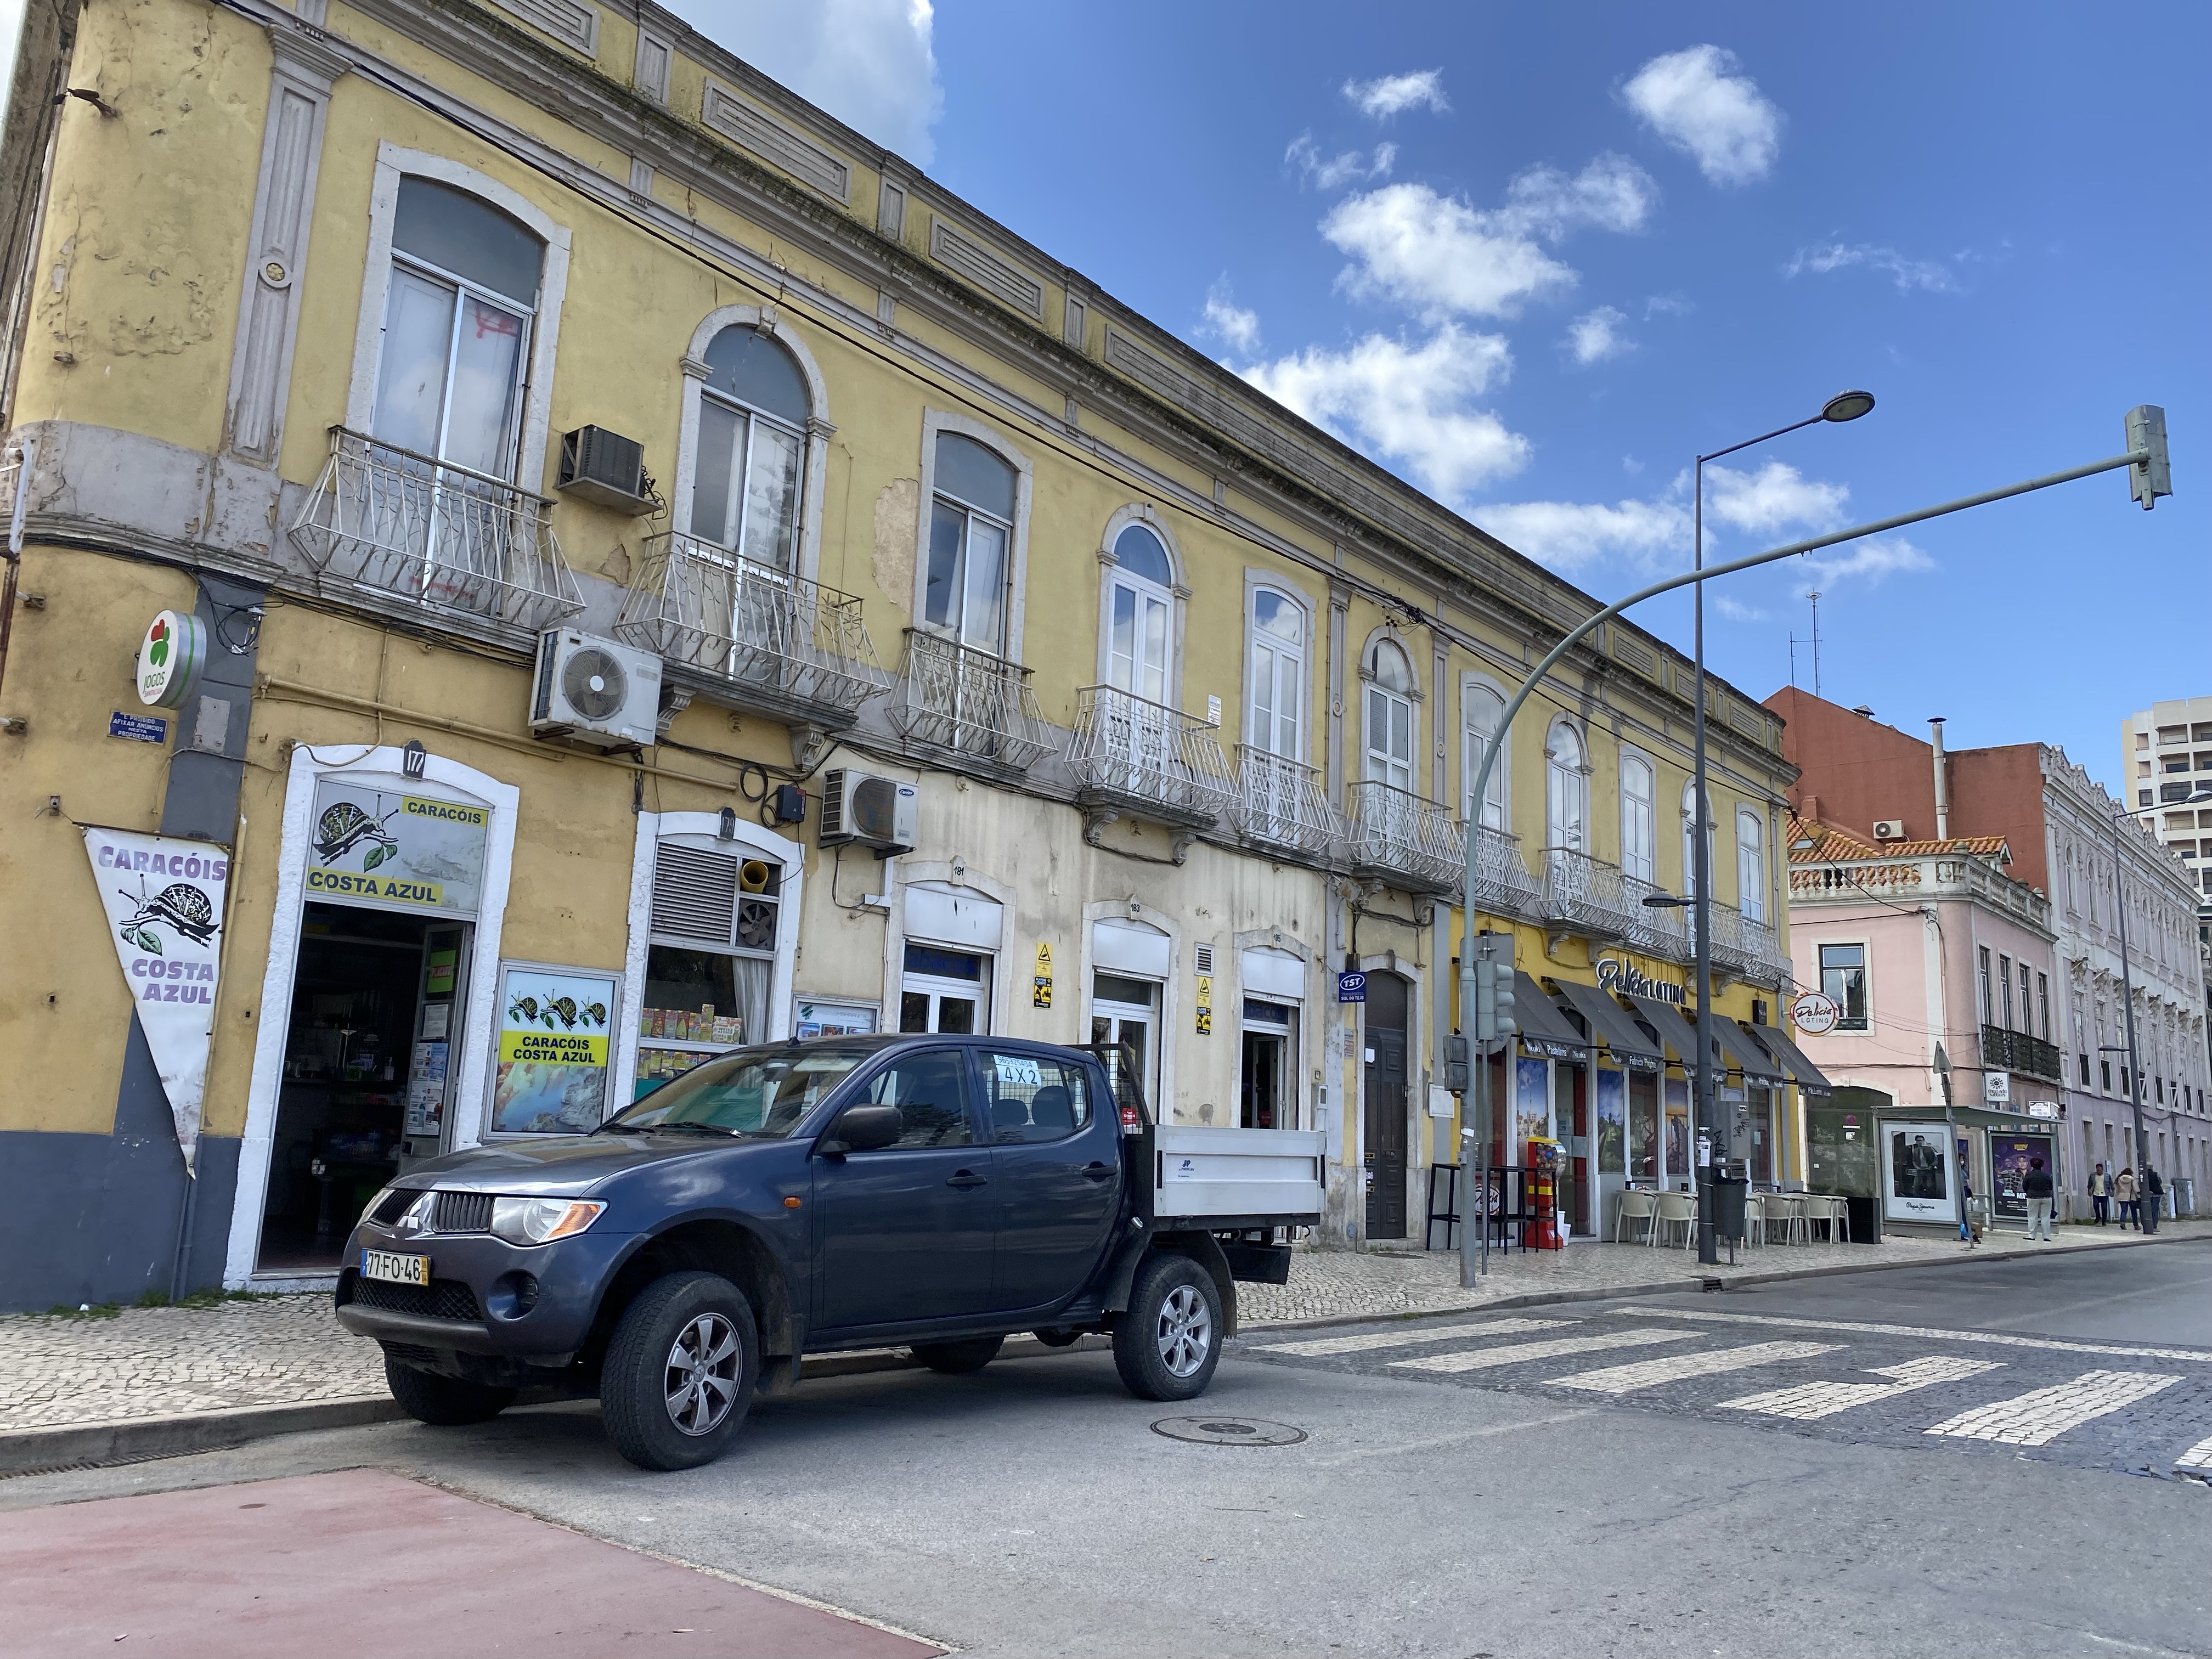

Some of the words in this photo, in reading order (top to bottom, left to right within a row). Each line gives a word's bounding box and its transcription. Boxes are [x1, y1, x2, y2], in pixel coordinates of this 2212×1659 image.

[143, 672, 166, 694] JOGOS
[112, 718, 135, 727] AFIXAR
[137, 722, 163, 732] ANÚNCIOS
[129, 715, 155, 724] PROIBIDO
[117, 730, 156, 742] PROPRIEDADE
[407, 802, 481, 824] CARACÓIS
[721, 816, 735, 834] 179
[98, 845, 227, 881] CARACÓIS
[953, 866, 964, 876] 181
[309, 871, 378, 894] COSTA
[384, 883, 437, 902] AZUL
[1131, 903, 1140, 913] 183
[132, 958, 214, 981] COSTA
[1344, 978, 1361, 988] TST
[142, 983, 212, 1005] AZUL
[522, 1036, 589, 1050] CARACÓIS
[513, 1048, 557, 1061] COSTA
[561, 1052, 595, 1063] AZUL
[1005, 1067, 1013, 1081] 4
[1015, 1068, 1026, 1084] X
[1029, 1070, 1037, 1085] 2
